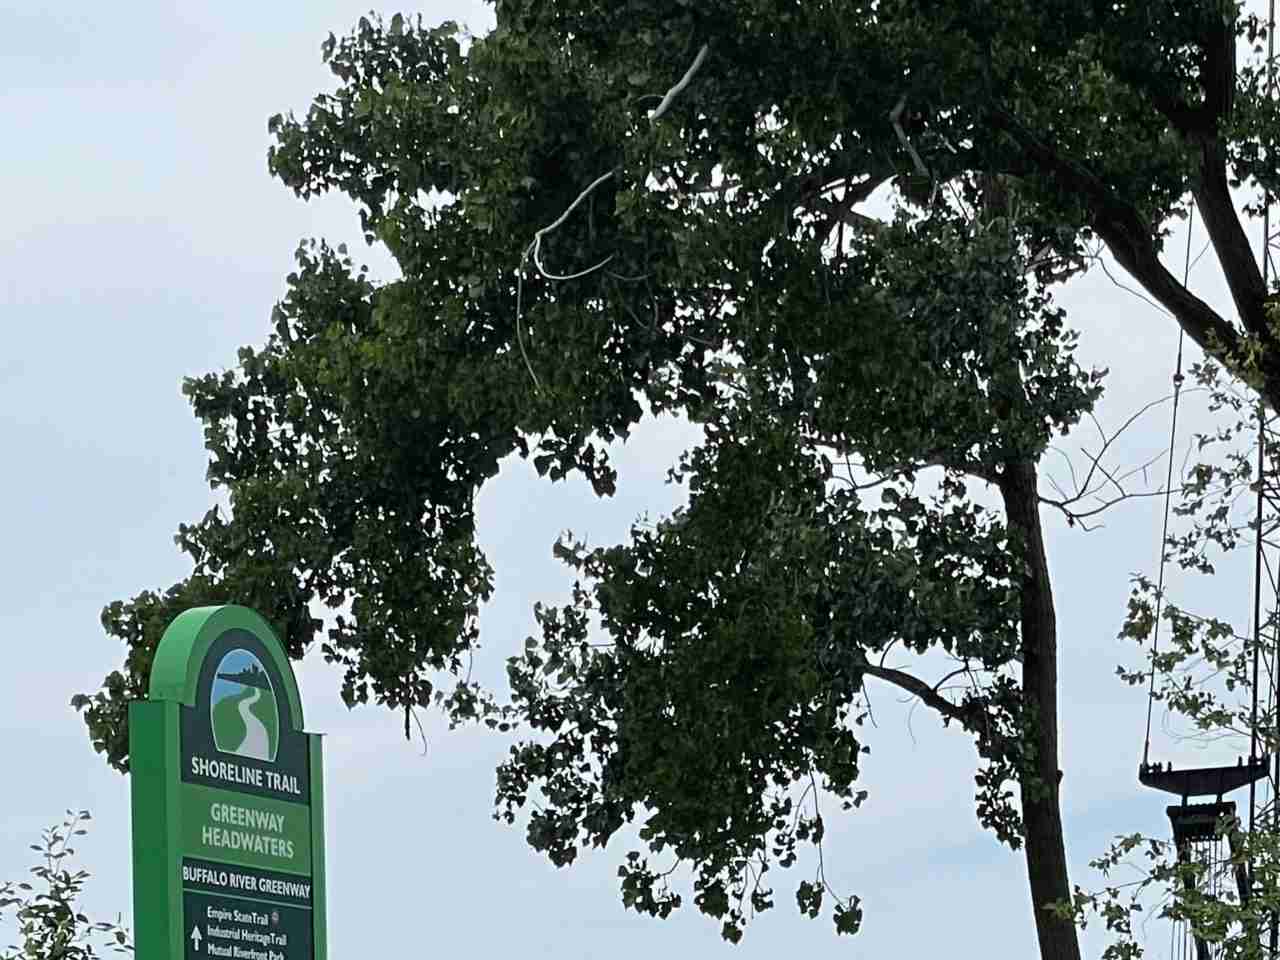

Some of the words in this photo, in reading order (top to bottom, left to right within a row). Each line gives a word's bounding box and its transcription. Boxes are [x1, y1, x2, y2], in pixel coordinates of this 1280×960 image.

[191, 756, 263, 787] SHORELINE
[265, 771, 301, 795] TRAIL
[211, 803, 285, 833] GREENWAY
[202, 825, 296, 859] HEADWATERS
[182, 866, 228, 886] BUFFALO
[229, 873, 257, 891] RIVER
[258, 878, 311, 899] GREENWAY
[207, 905, 232, 923] Empire
[251, 912, 269, 926] Trail
[207, 924, 240, 940] Industrial
[241, 929, 270, 946] Heritage
[270, 932, 287, 946] Trail
